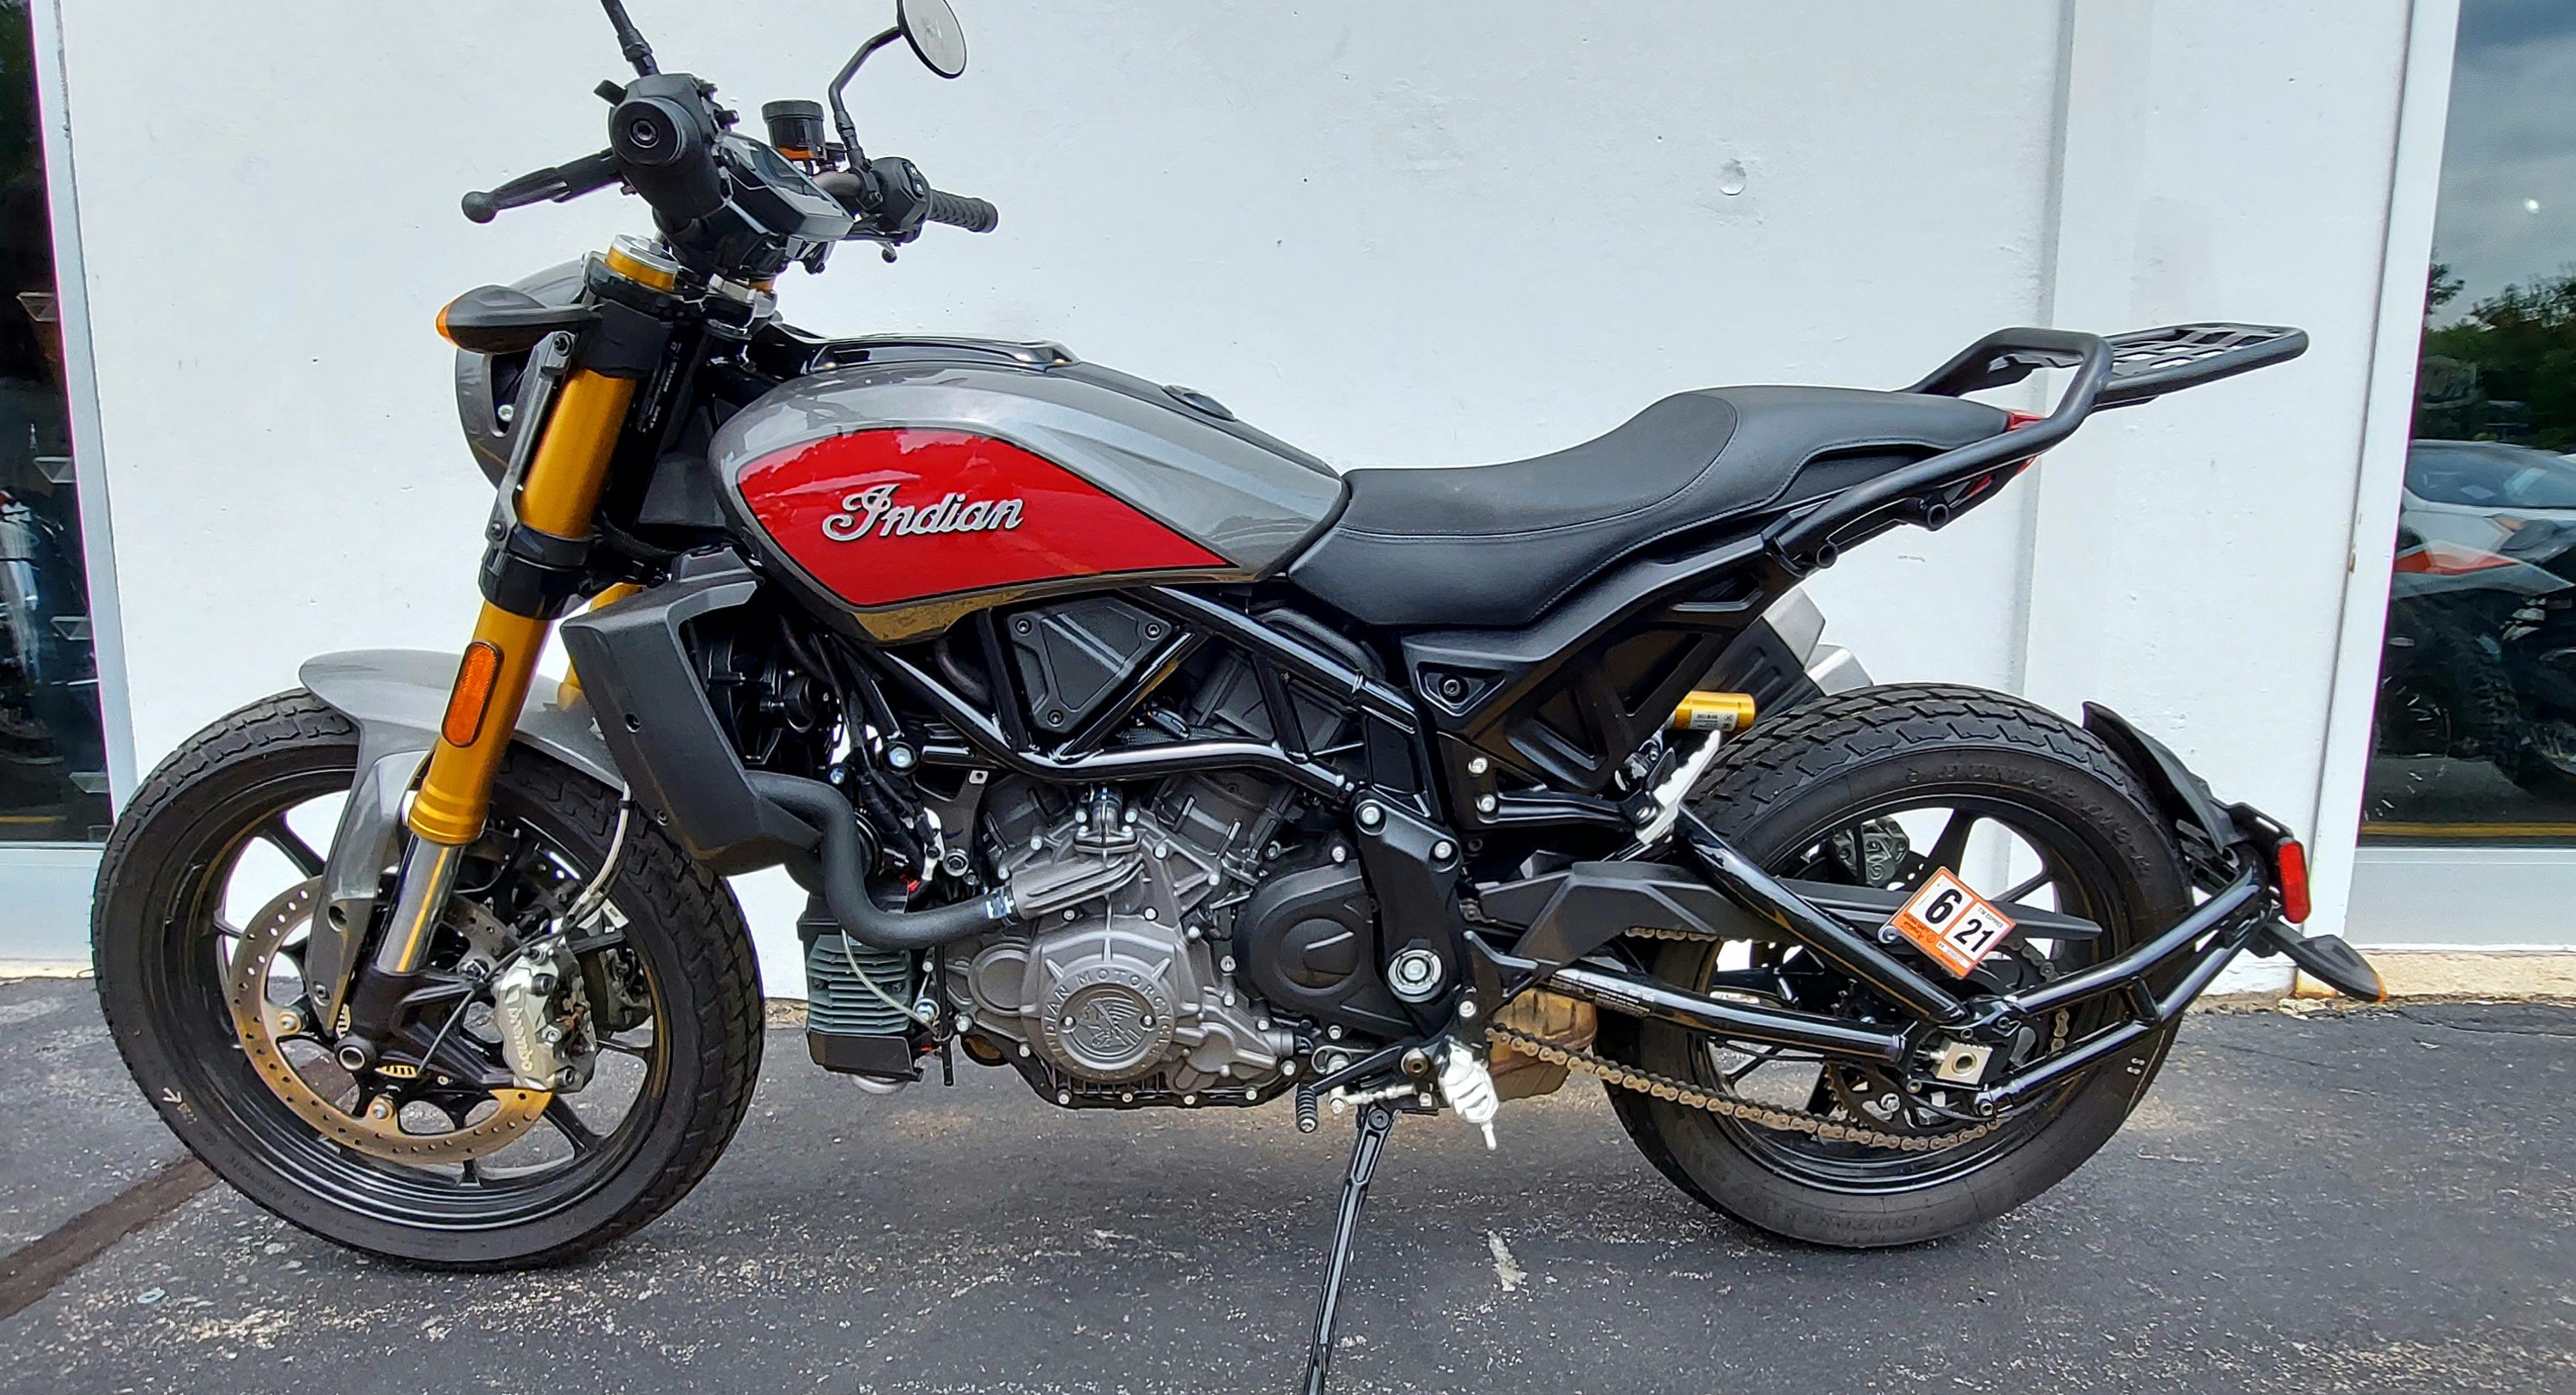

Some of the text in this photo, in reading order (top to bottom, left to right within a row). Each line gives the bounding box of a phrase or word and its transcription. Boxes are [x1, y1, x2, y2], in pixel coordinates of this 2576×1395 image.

[821, 483, 1024, 542] Indian
[1925, 888, 1963, 925] 6
[1953, 918, 1994, 953] 21
